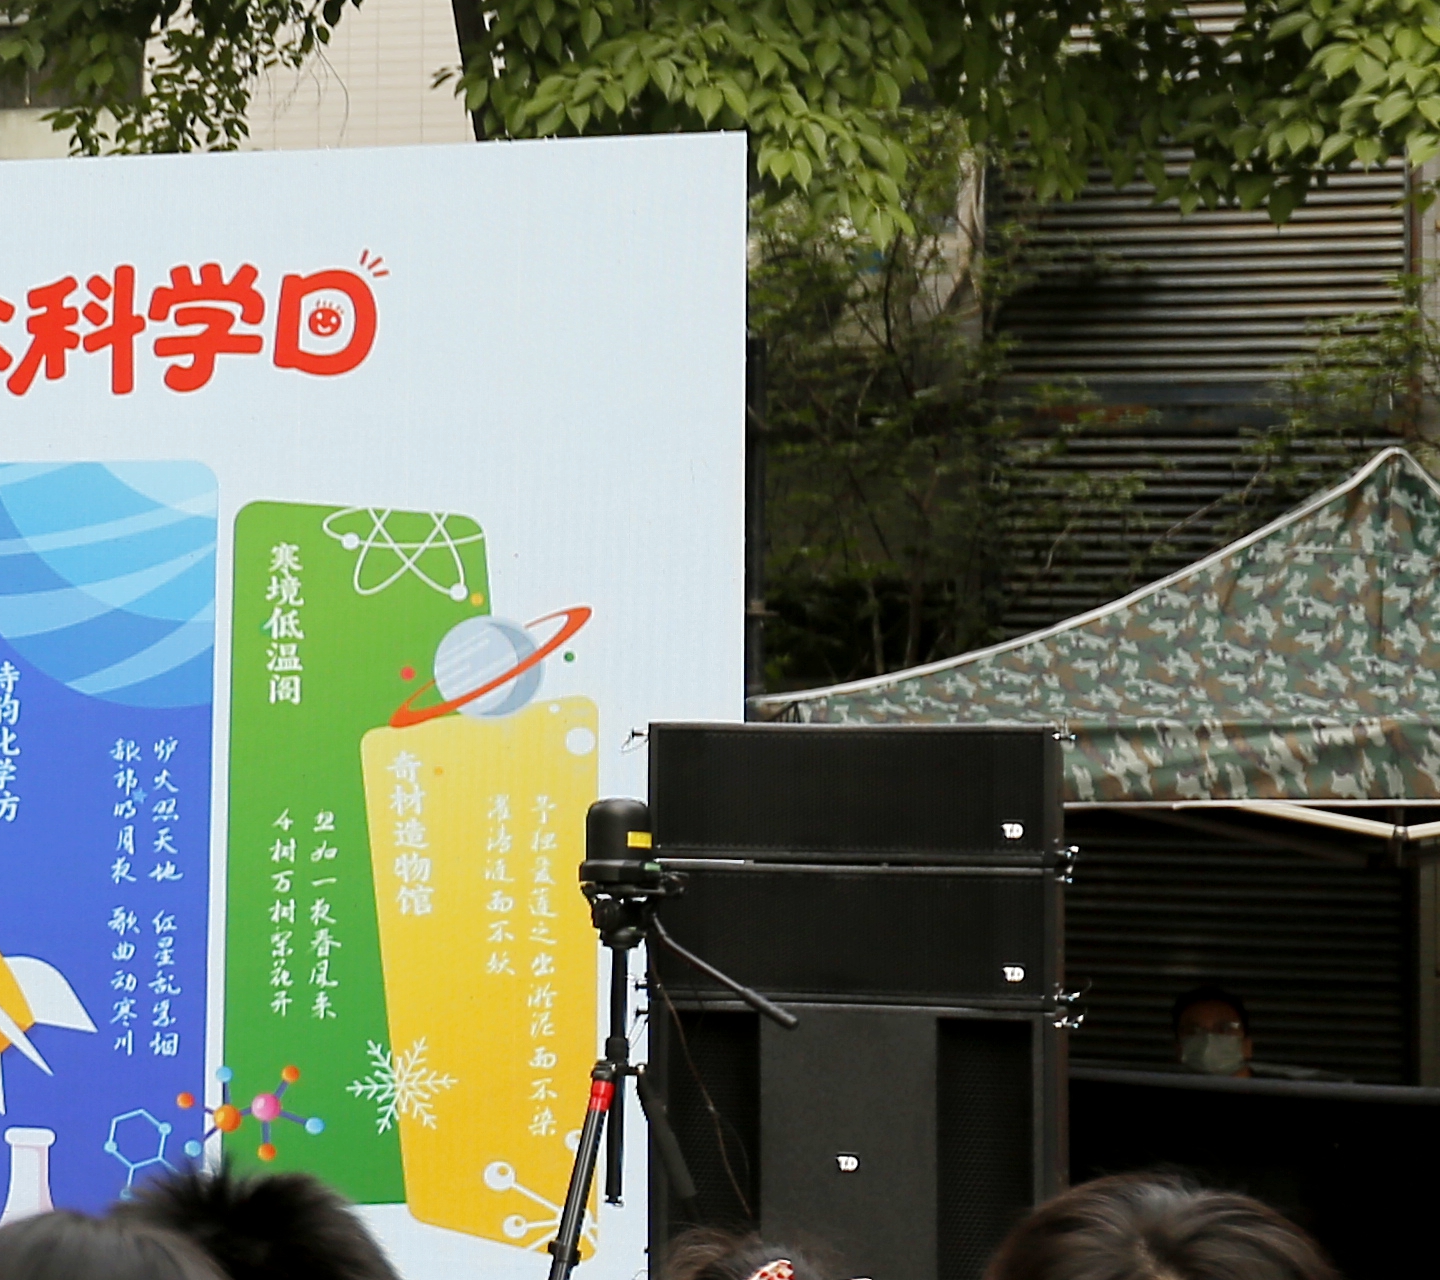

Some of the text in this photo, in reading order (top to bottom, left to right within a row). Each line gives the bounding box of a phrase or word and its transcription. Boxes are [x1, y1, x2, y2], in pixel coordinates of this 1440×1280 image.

[263, 541, 305, 705] 寒境低温阁
[387, 750, 435, 917] 奇材造物馆
